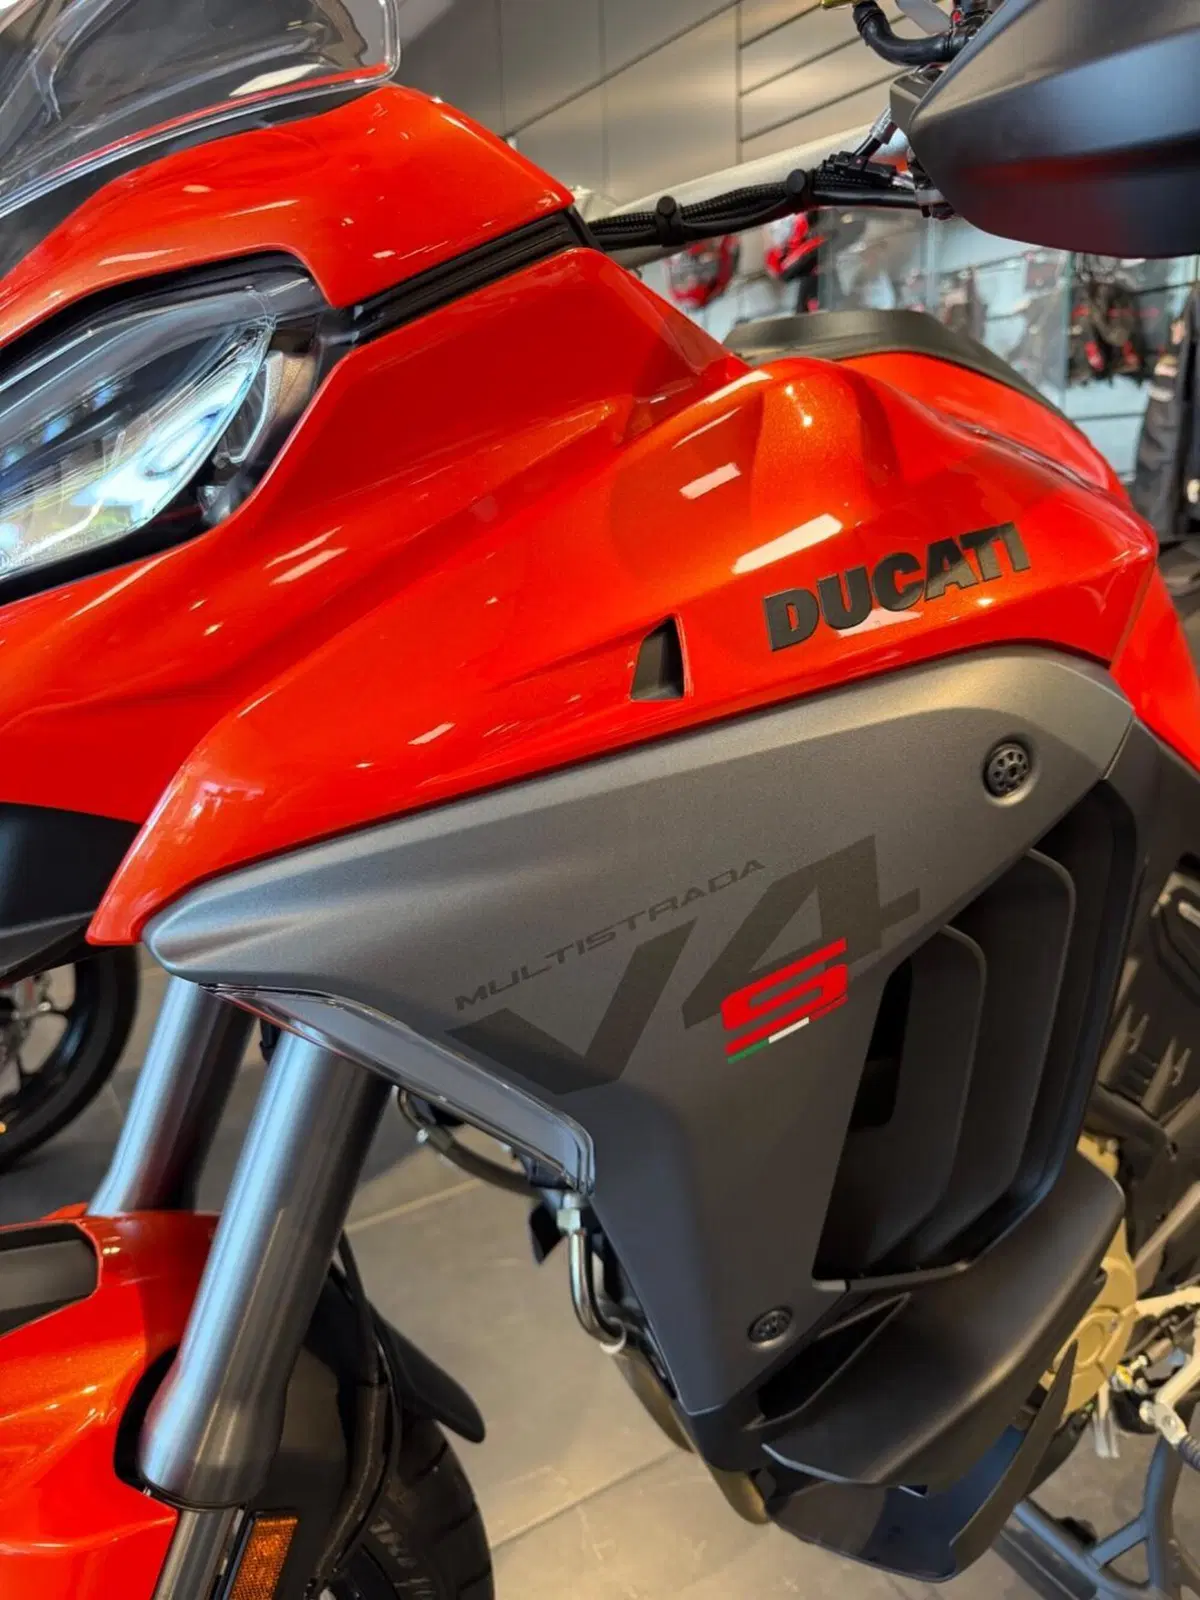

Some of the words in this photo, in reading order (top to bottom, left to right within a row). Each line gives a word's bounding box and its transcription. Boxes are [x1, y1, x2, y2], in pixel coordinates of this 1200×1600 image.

[764, 521, 1031, 651] DUCATI
[444, 834, 921, 1095] V4
[720, 936, 849, 1057] S
[455, 859, 766, 1011] MULTISTRADA
